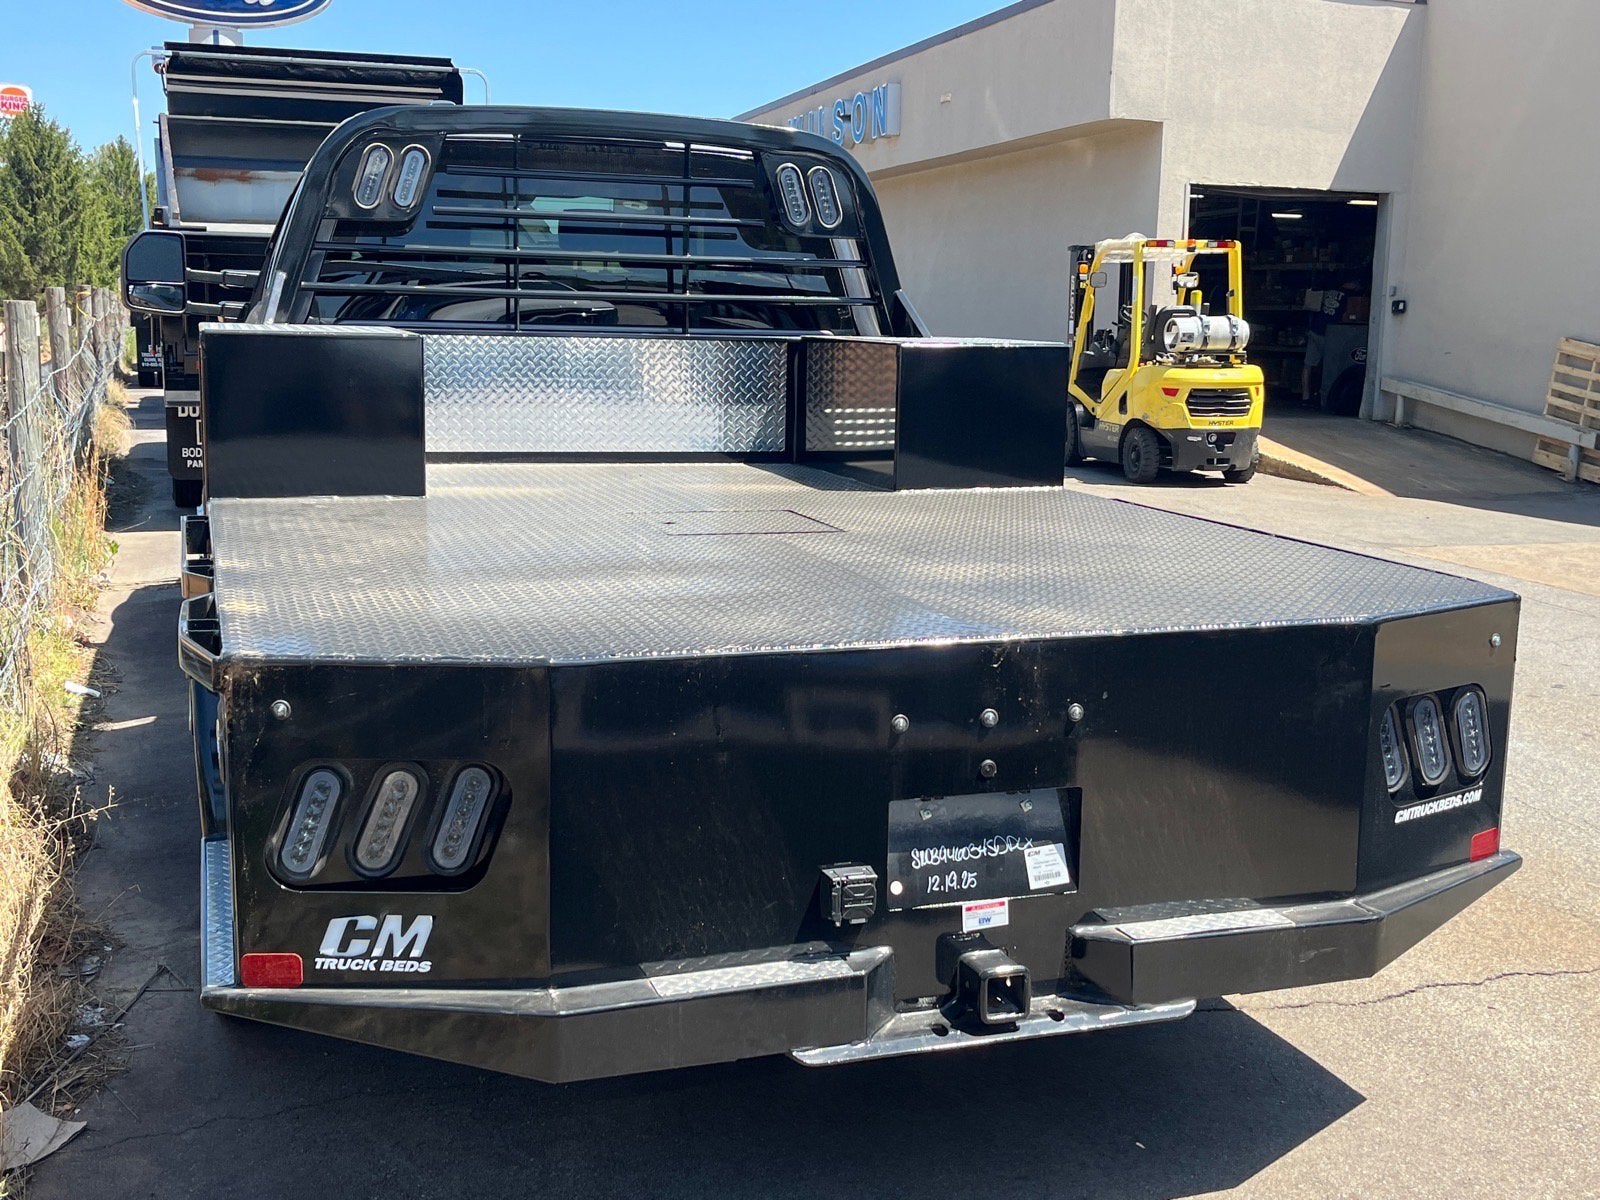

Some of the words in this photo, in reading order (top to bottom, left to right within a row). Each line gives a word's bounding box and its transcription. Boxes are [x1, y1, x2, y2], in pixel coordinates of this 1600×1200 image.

[0, 101, 27, 111] KING
[788, 83, 888, 146] ILSON
[1099, 421, 1120, 433] HYSTER
[1394, 788, 1483, 825] CMTRUCKBEDS.COM
[319, 914, 434, 958] CM
[314, 957, 379, 972] TRUCK
[379, 959, 433, 973] BEDS
